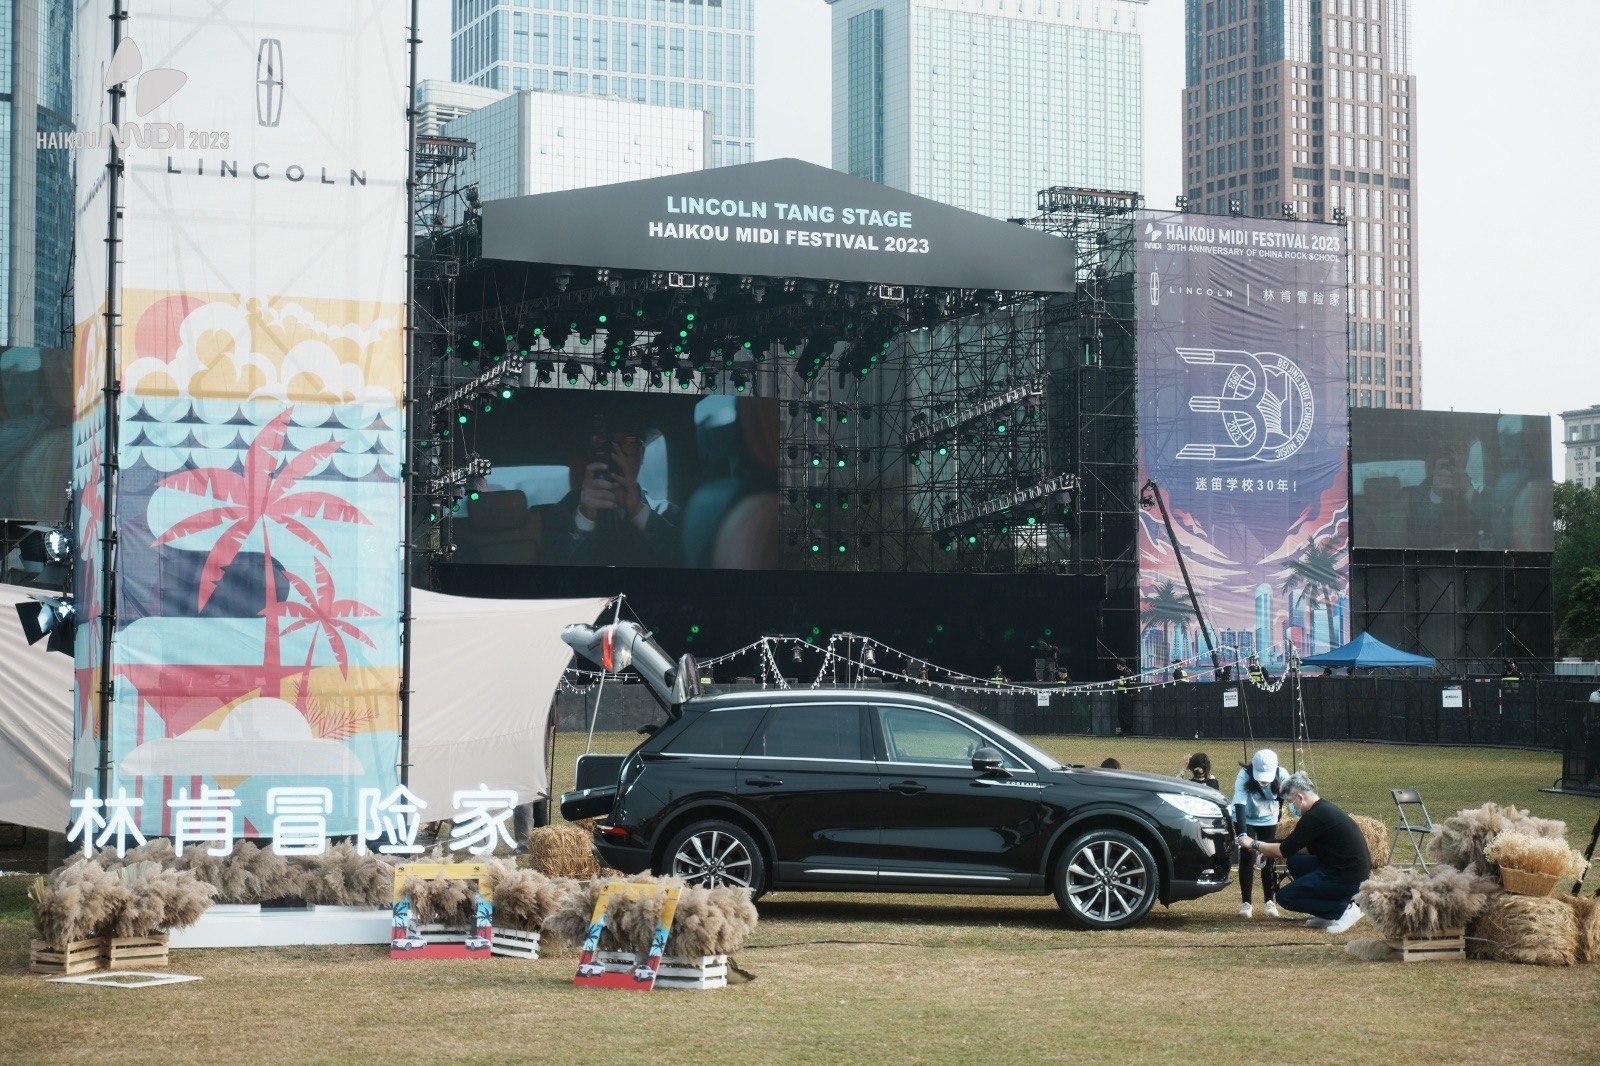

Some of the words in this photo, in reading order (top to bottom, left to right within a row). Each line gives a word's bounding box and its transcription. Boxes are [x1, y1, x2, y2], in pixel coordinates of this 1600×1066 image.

[167, 156, 367, 186] LINCOLN
[667, 195, 767, 219] LINCOLN
[774, 202, 835, 223] TANG
[842, 207, 912, 228] STAGE
[649, 221, 729, 241] HAIKOU
[736, 227, 779, 244] MIDI
[786, 230, 879, 251] FESTIVAL
[884, 236, 930, 254] 2023
[1166, 224, 1215, 243] HAIKOU
[1218, 228, 1248, 246] MIDI
[1252, 231, 1309, 249] FESTIVAL
[1311, 235, 1340, 252] 2023
[1166, 243, 1187, 251] 30TH
[1188, 245, 1244, 256] ANNIVERSARY
[1246, 248, 1257, 257] OF
[1258, 249, 1284, 259] CHINA
[1284, 251, 1307, 260] ROCK
[1308, 252, 1341, 263] SCHOOL
[1169, 286, 1233, 297] LINCOLN
[1262, 289, 1340, 307] 林肯冒险家
[1298, 380, 1311, 400] MIDI
[1299, 401, 1312, 433] SCHOOL
[1226, 420, 1242, 442] 2023
[1295, 432, 1304, 446] OF
[1275, 441, 1298, 459] MUSIC
[67, 783, 519, 859] 林肯冒险家
